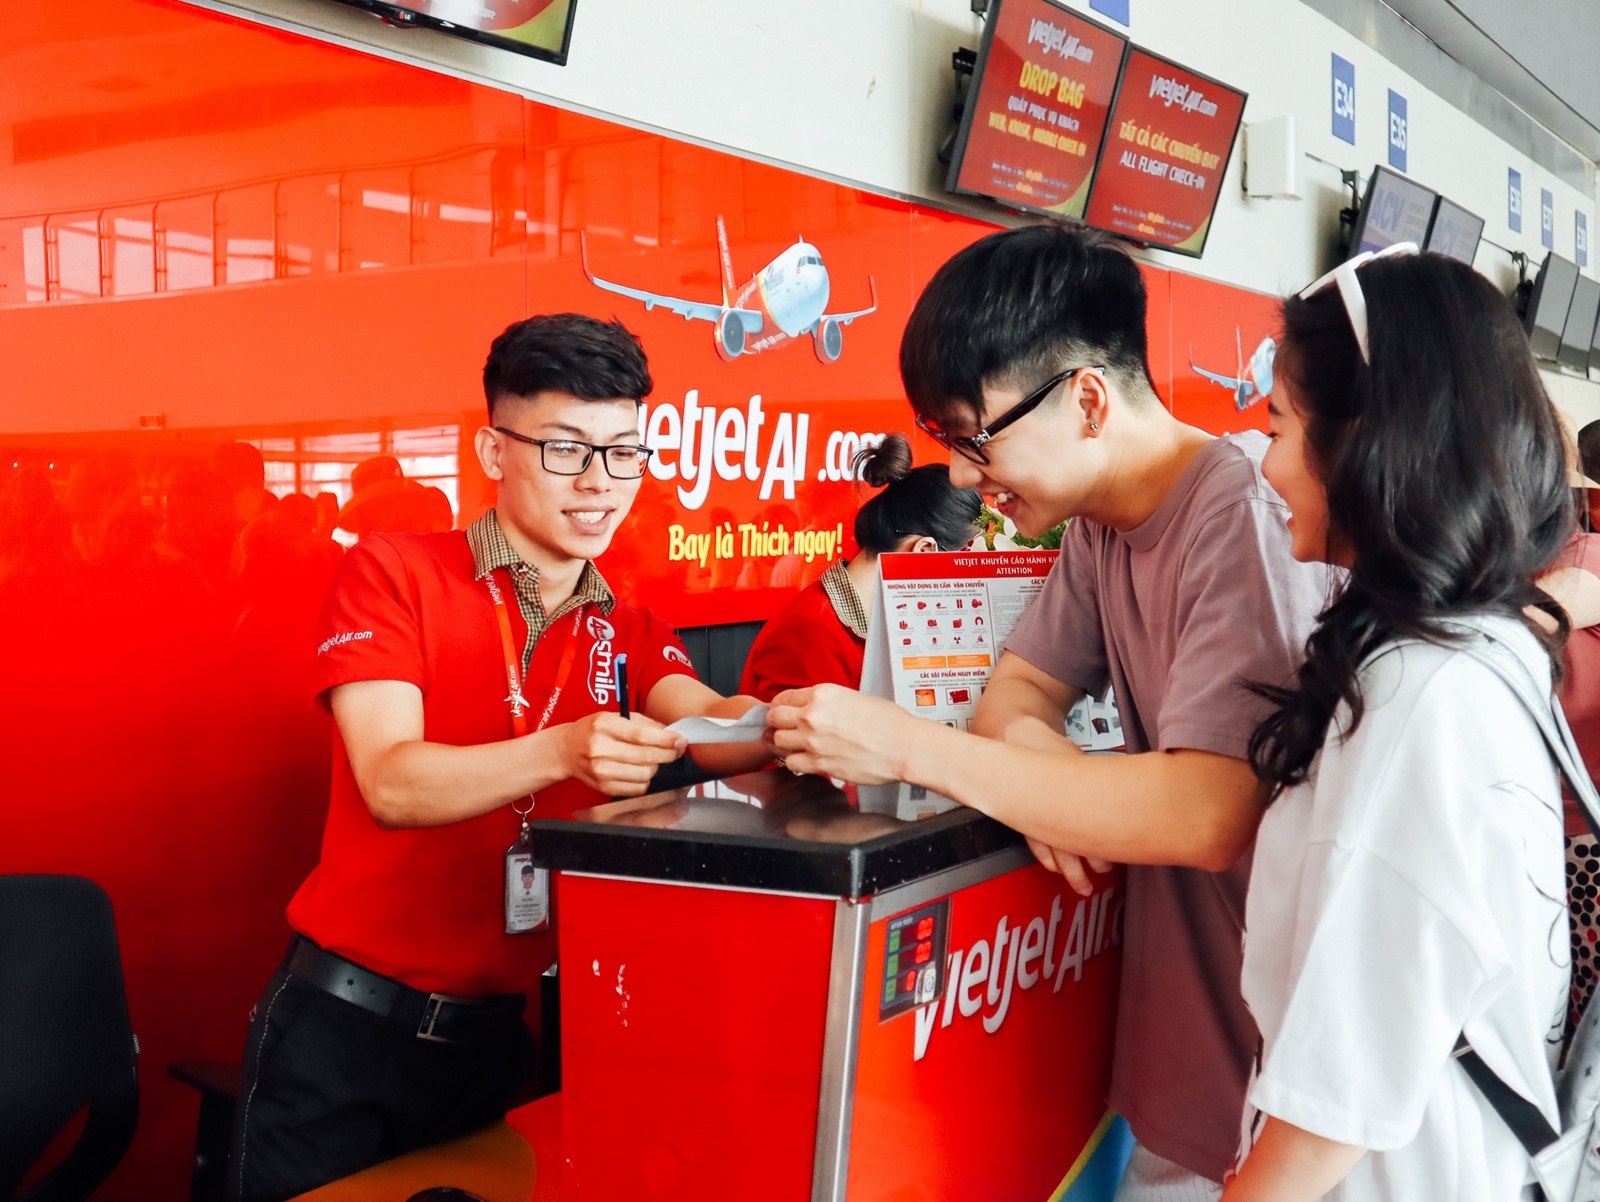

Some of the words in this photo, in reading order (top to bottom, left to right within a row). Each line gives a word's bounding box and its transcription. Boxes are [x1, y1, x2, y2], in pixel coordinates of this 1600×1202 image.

[1019, 61, 1058, 97] DROP
[1057, 76, 1085, 109] BAG
[1334, 78, 1354, 122] E34
[1390, 112, 1406, 151] E35
[1119, 151, 1137, 168] ALL
[1138, 156, 1169, 178] FLIGHT
[1368, 188, 1406, 234] ACV
[668, 524, 711, 568] Bay
[715, 521, 734, 558] là
[738, 521, 789, 558] Thích
[794, 522, 843, 563] ngay!
[953, 557, 978, 567] VIETJET
[980, 555, 1009, 565] KHUYẾN
[1010, 556, 1025, 565] CÁO
[1026, 555, 1047, 564] HÀNH
[996, 567, 1033, 575] ATTENTION
[595, 640, 617, 705] smile
